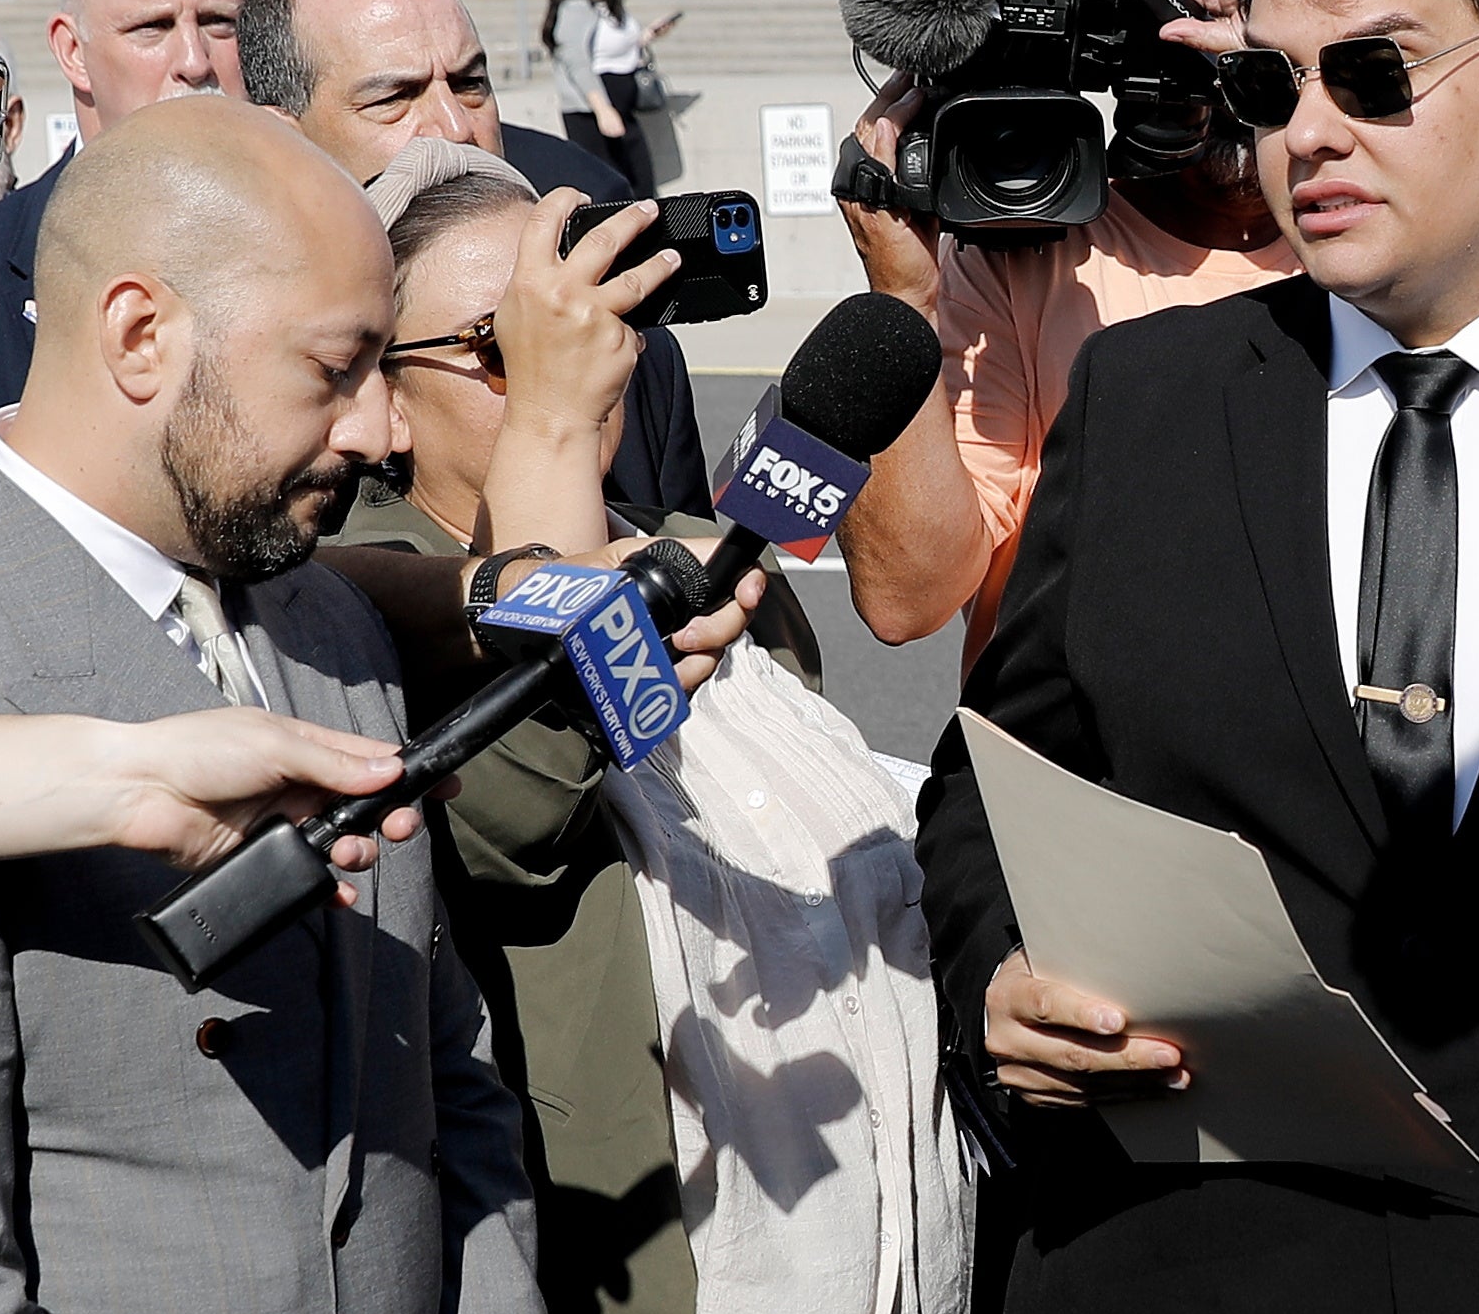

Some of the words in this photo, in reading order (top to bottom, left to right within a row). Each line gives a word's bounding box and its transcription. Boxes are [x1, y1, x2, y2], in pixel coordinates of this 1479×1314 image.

[787, 115, 806, 130] NO
[743, 473, 779, 498] NEW
[784, 496, 829, 528] YORK
[749, 446, 823, 505] FOX
[813, 484, 847, 515] 5
[505, 572, 586, 609] PIX
[589, 594, 661, 707] PIX
[568, 632, 589, 663] NEW
[581, 658, 608, 704] YORK'S
[601, 698, 622, 732] VERY
[614, 728, 634, 760] OWN
